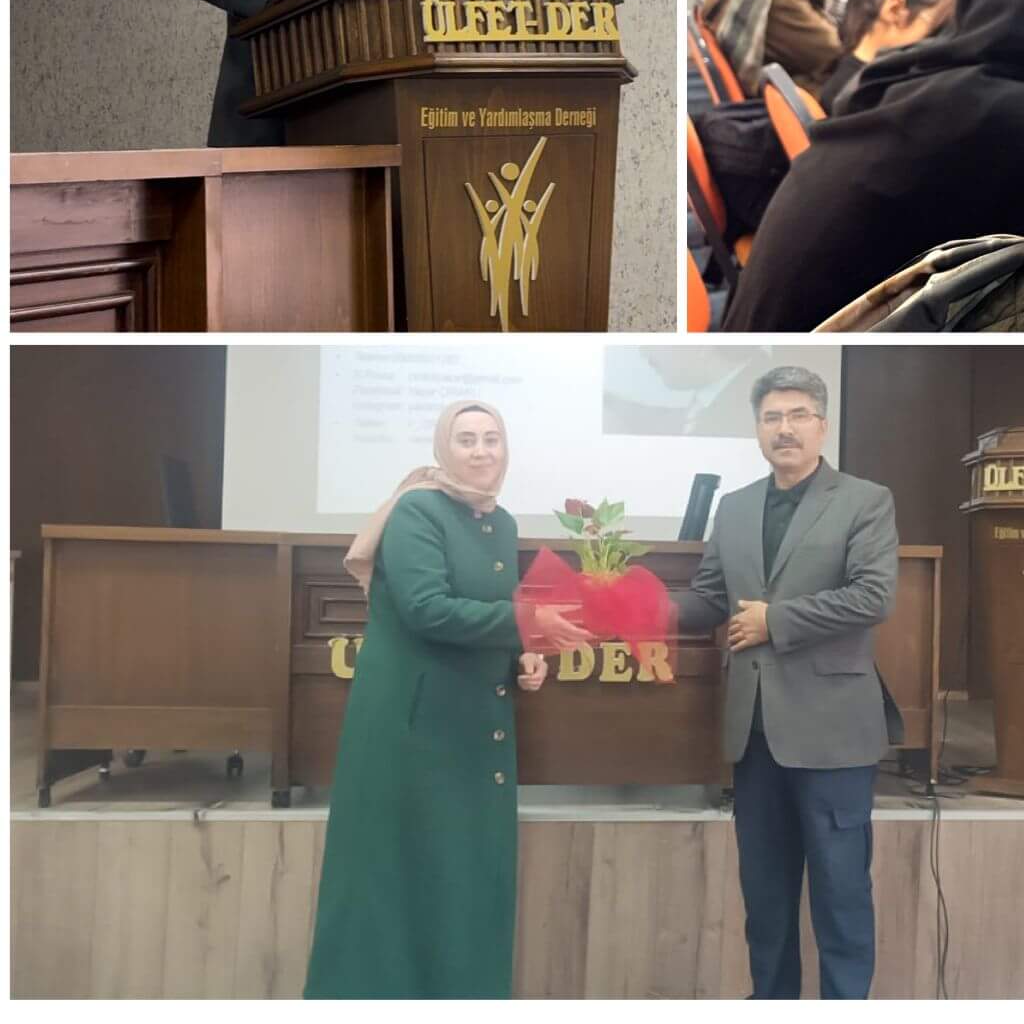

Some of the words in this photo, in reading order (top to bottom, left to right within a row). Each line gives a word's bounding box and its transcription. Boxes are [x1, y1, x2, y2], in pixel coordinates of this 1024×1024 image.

[421, 107, 458, 129] Eğitim
[462, 112, 476, 126] ve
[479, 107, 551, 129] Yardımlaşma
[555, 107, 597, 128] Derneği
